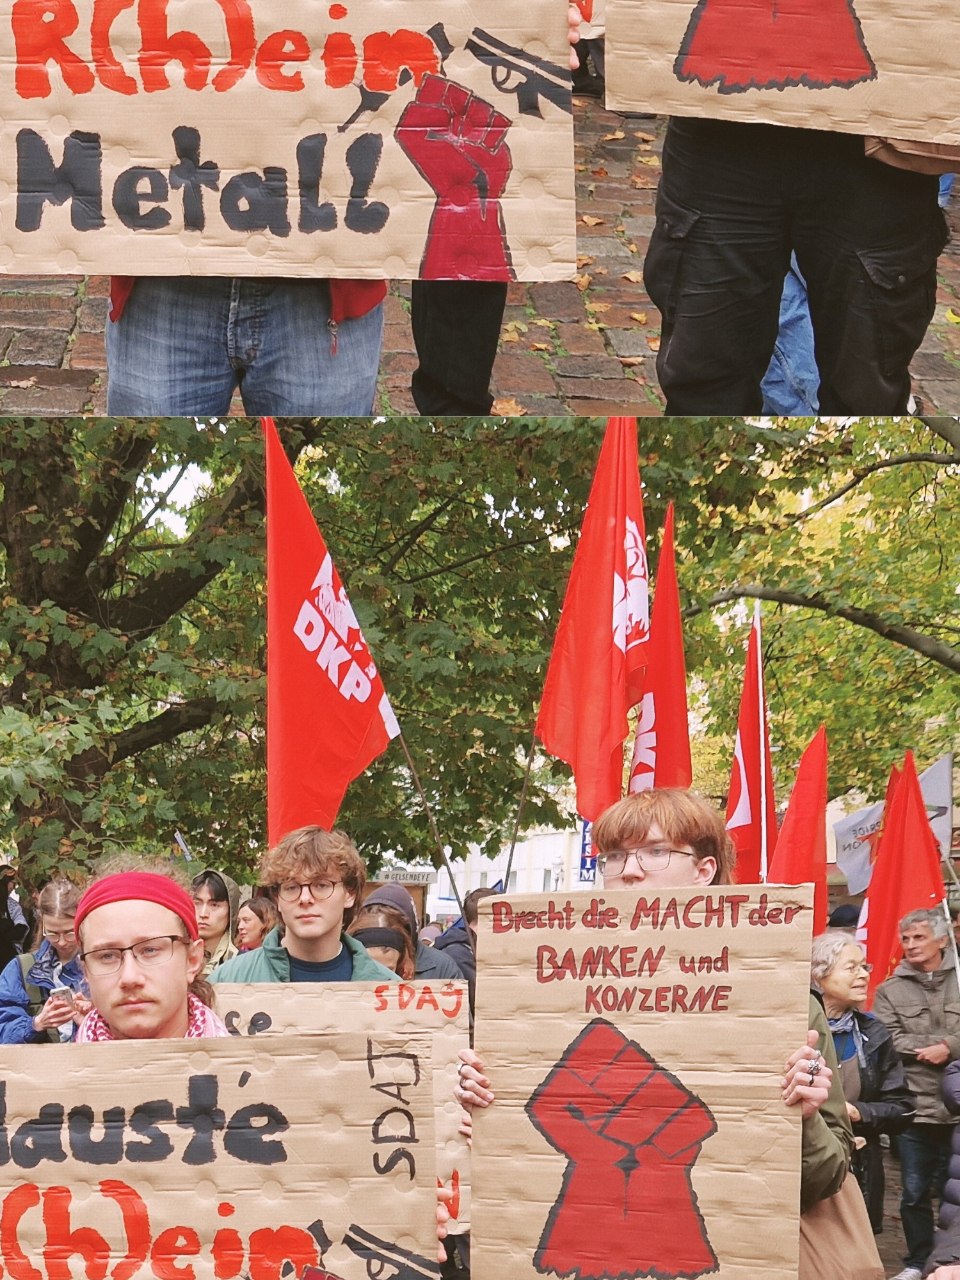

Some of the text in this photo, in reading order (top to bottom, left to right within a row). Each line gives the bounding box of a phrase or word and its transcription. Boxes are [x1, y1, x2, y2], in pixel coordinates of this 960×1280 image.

[14, 125, 390, 237] Metall
[292, 599, 372, 703] DKP
[491, 898, 575, 934] Brecht
[581, 897, 619, 930] die
[630, 895, 750, 931] MACHT
[536, 944, 730, 983] BANKEN und
[373, 984, 464, 1018] SDAJ
[585, 985, 733, 1014] KONZERNE
[366, 1037, 422, 1181] SDAJ
